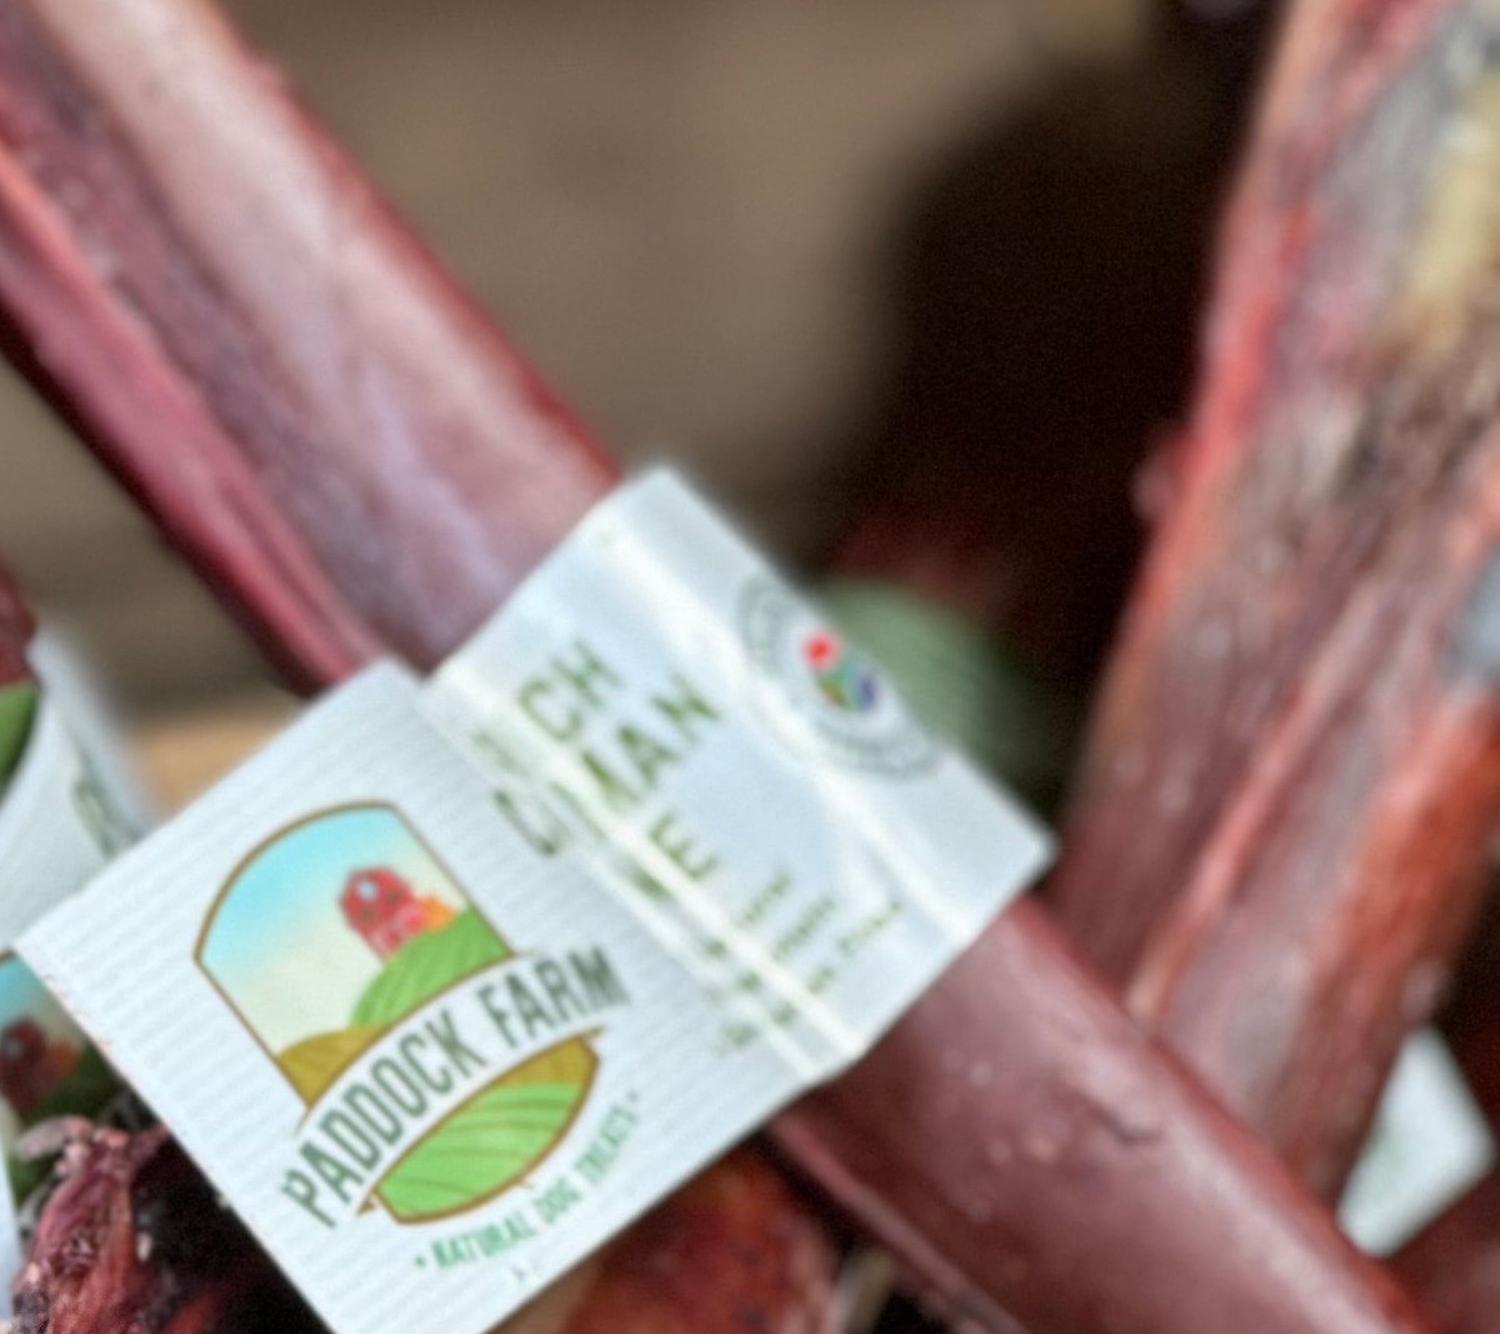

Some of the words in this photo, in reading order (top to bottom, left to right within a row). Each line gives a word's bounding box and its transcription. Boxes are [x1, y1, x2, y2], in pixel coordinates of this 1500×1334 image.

[280, 1010, 488, 1230] PADDOCK
[477, 947, 630, 1048] FARM
[432, 1211, 535, 1268] NATURAL
[532, 1176, 583, 1226] DOG
